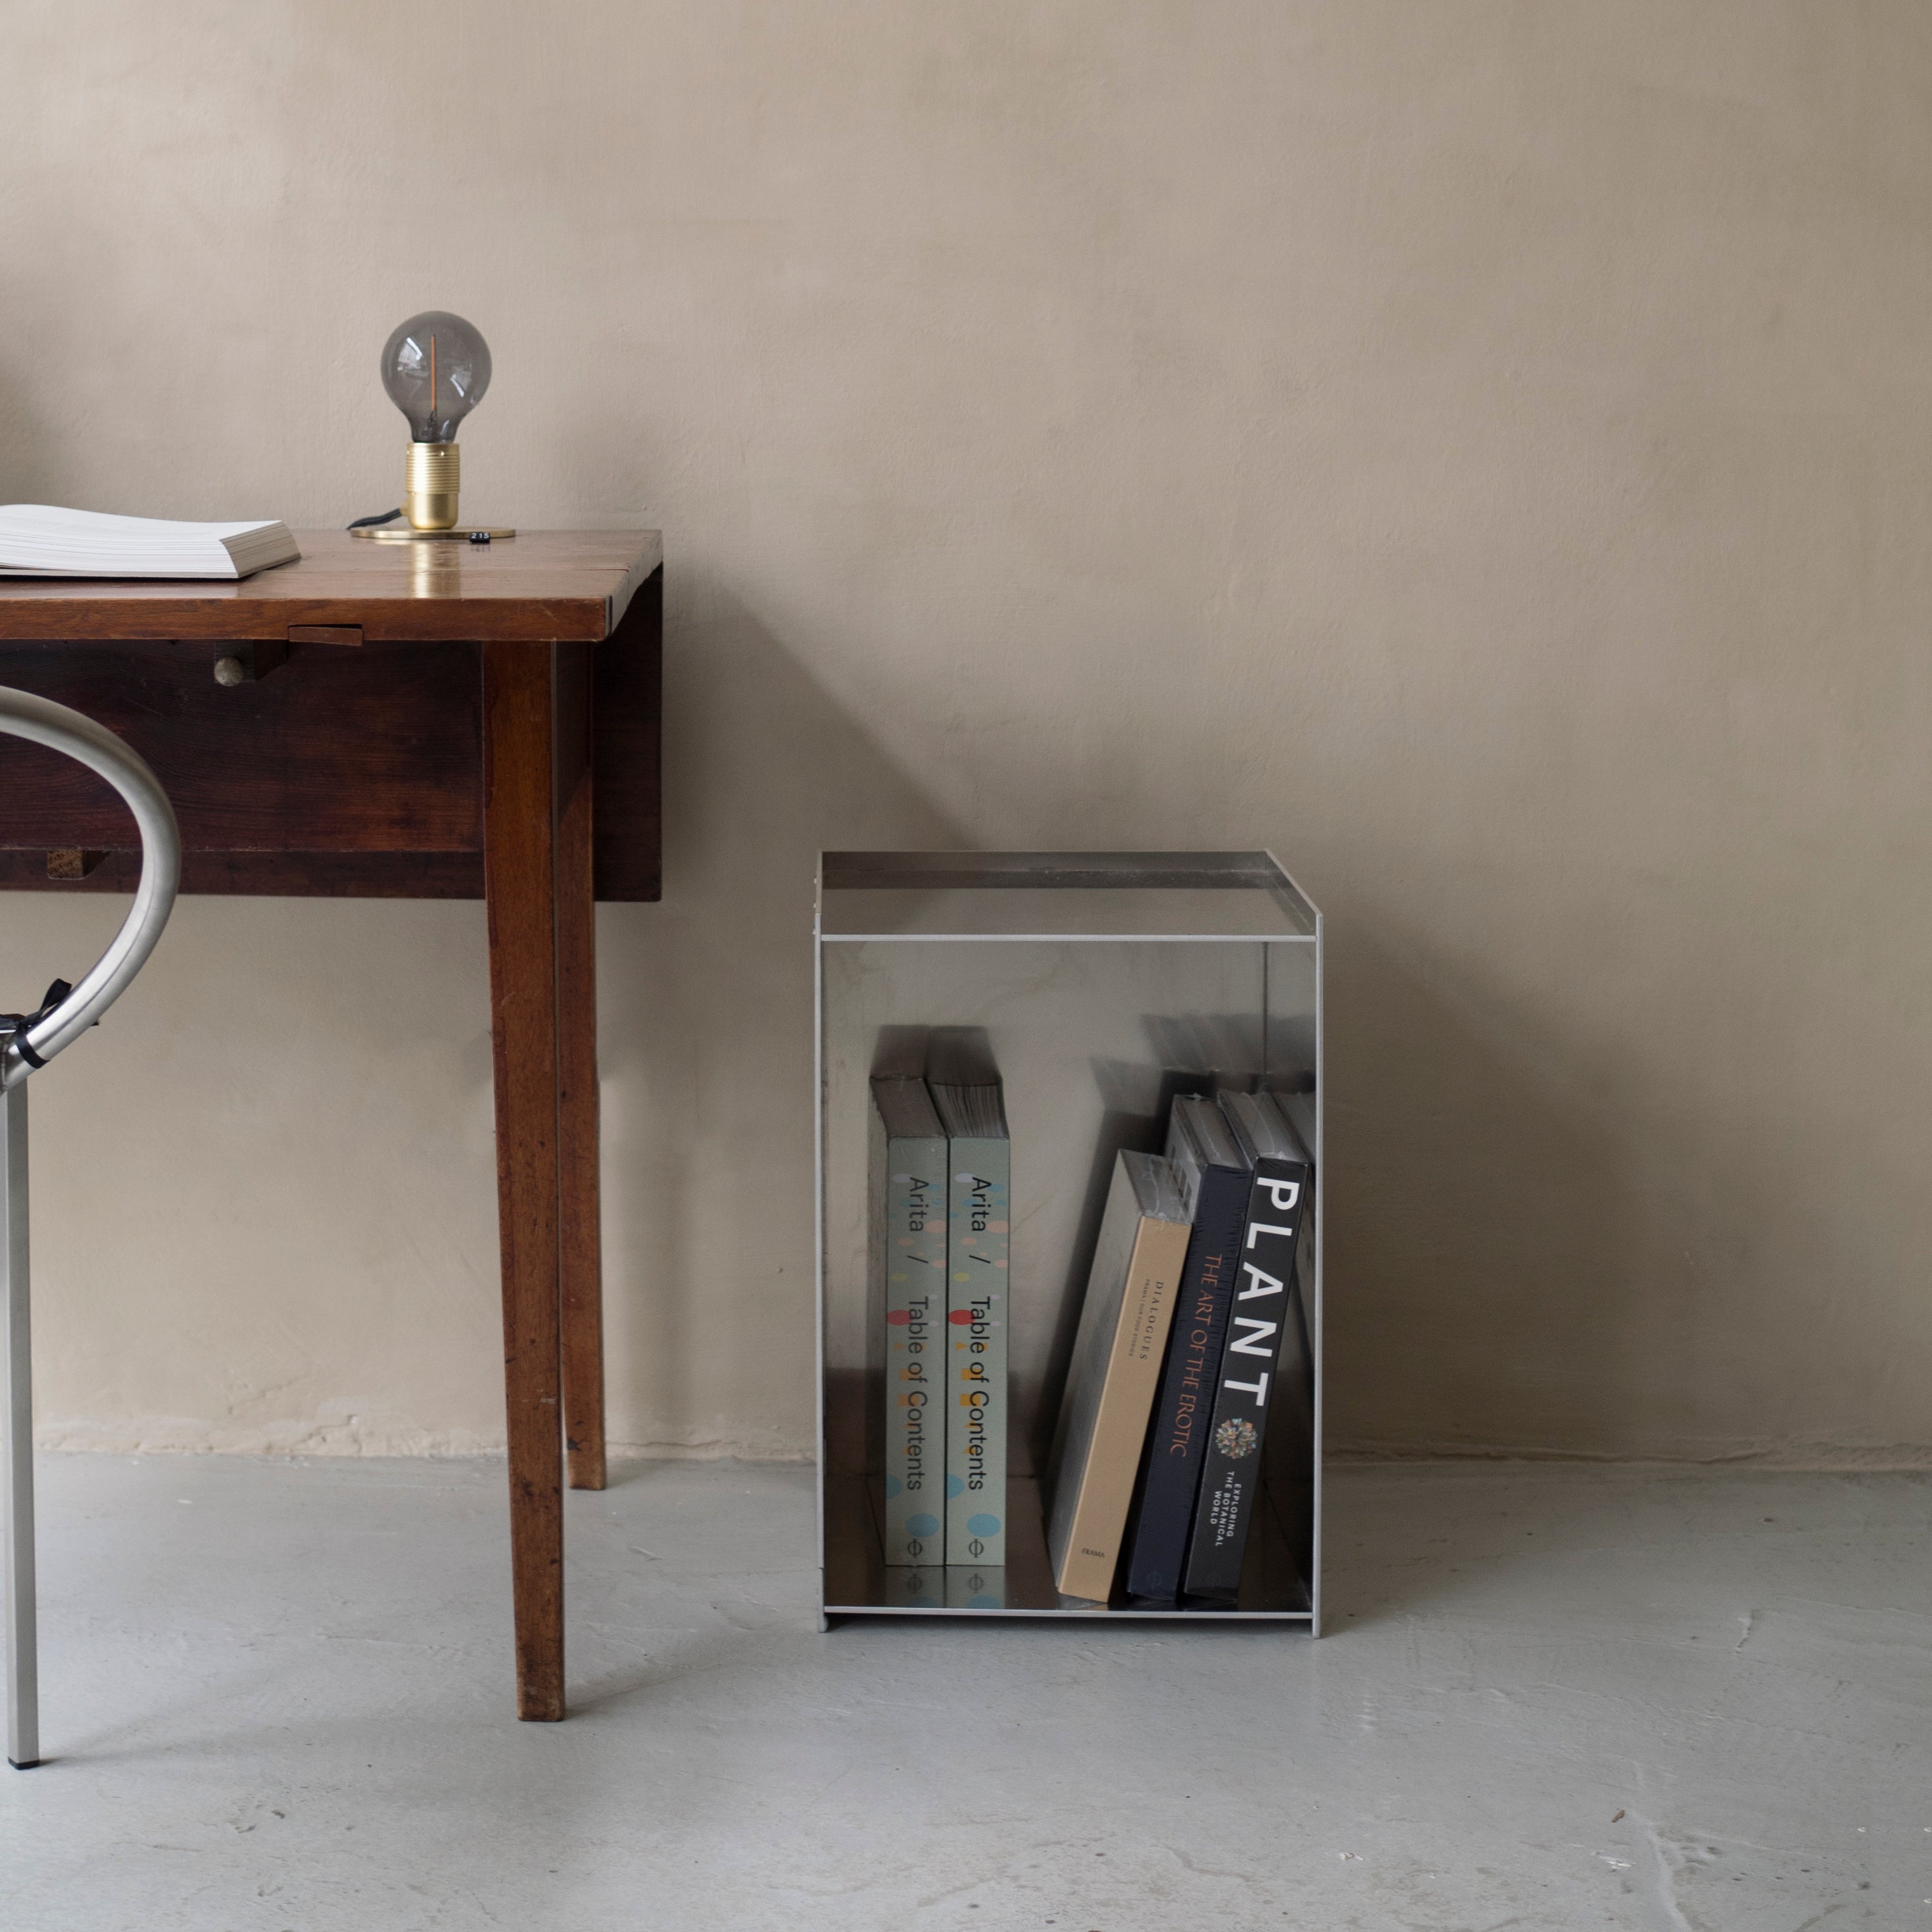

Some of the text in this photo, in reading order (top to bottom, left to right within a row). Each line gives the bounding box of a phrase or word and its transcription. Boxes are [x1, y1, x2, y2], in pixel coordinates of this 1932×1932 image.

[909, 1176, 930, 1232] Arita
[971, 1176, 992, 1232] Arita
[1139, 1281, 1164, 1360] DIALOGUES
[1224, 1177, 1300, 1407] PLANT
[908, 1296, 928, 1354] Table
[970, 1296, 991, 1354] Table
[907, 1362, 928, 1383] of
[970, 1362, 990, 1383] of
[1170, 1254, 1223, 1458] THE ART OF THE EROTIC
[907, 1391, 928, 1491] Contents
[968, 1391, 989, 1491] Contents
[1210, 1490, 1223, 1525] WORLD
[1215, 1471, 1235, 1547] THE BOTANICAL
[1226, 1483, 1242, 1538] EXPLORING
